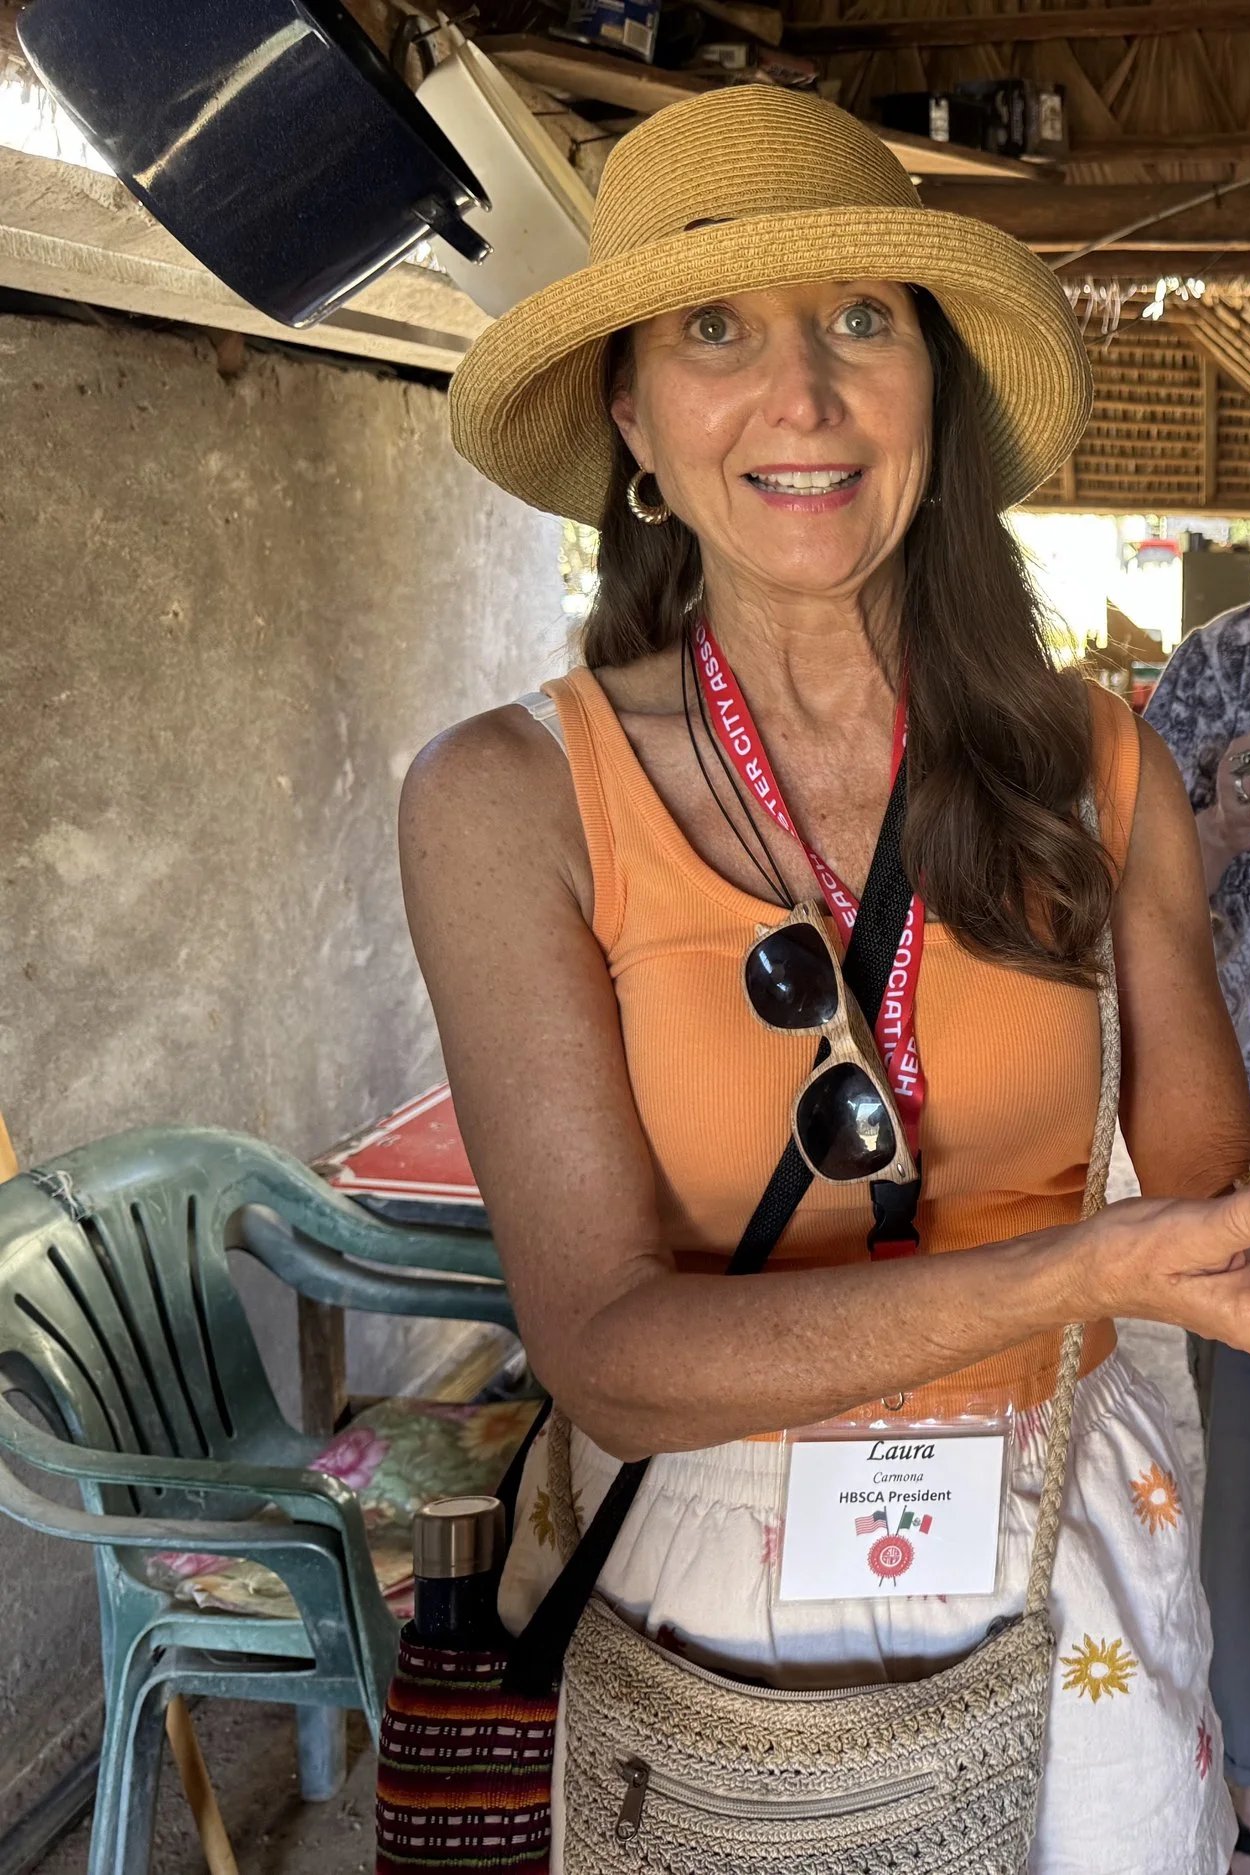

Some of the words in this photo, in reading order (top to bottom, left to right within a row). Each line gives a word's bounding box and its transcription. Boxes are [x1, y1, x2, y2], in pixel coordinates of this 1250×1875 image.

[716, 698, 752, 757] CITY
[746, 757, 795, 837] STER
[810, 853, 858, 929] EACH
[866, 1440, 935, 1461] Laura
[839, 1490, 885, 1504] HBSCA
[888, 1488, 952, 1503] President
[873, 1472, 924, 1484] Carmona
